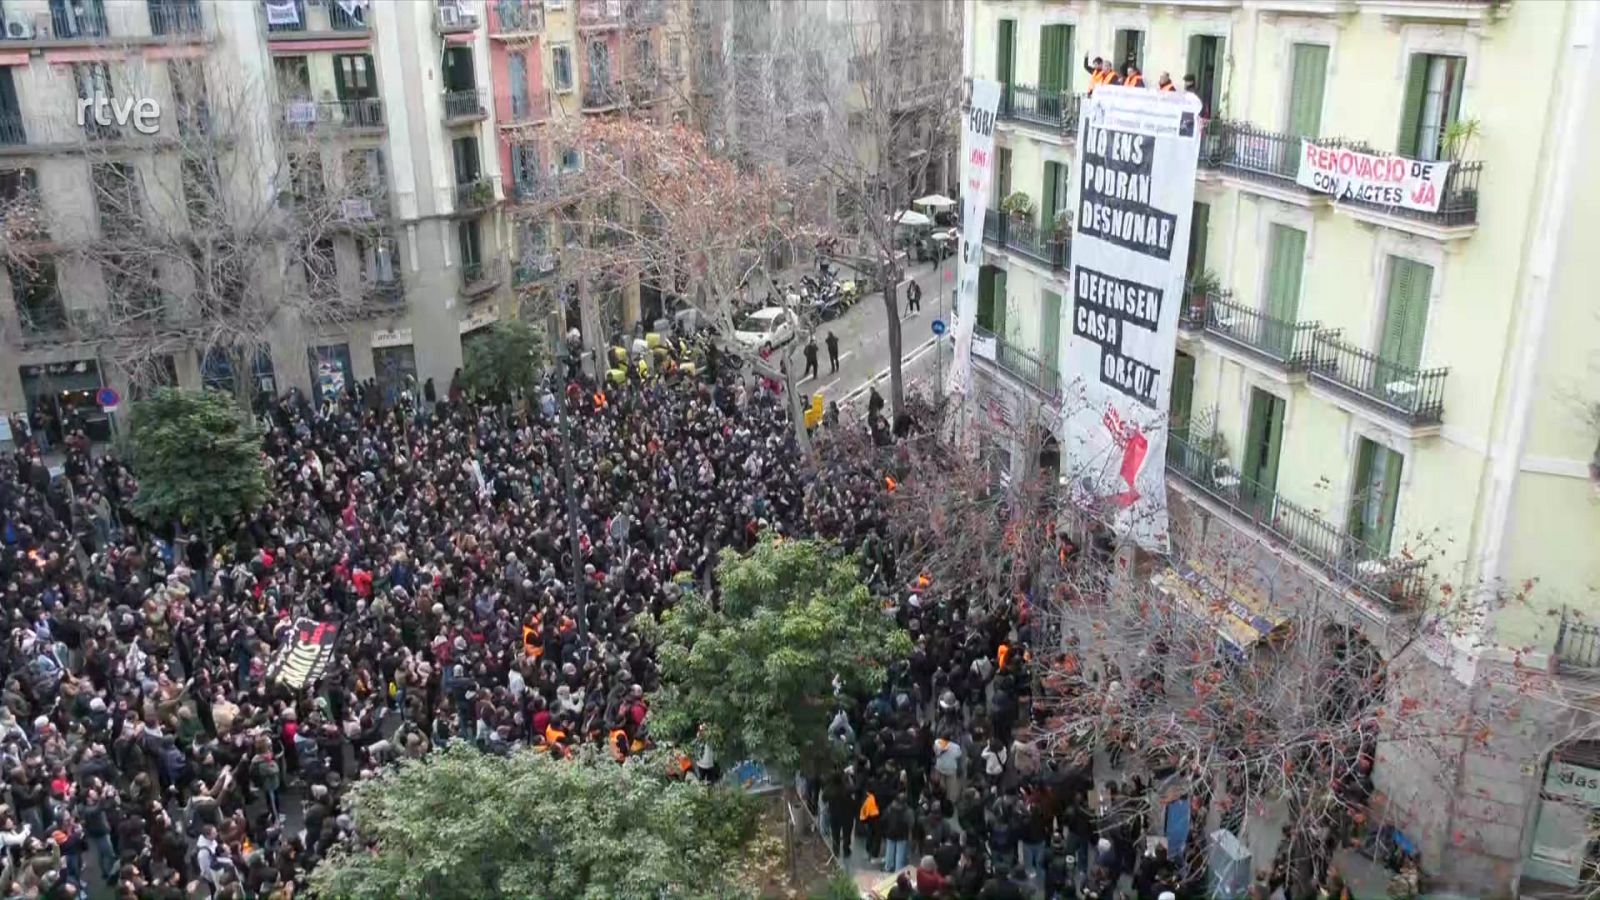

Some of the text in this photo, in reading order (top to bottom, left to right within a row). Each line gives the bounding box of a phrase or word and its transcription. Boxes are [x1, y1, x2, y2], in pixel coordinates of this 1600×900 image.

[1086, 127, 1144, 165] NO ENS
[1084, 164, 1151, 204] PODRAN
[1314, 172, 1402, 203] CONACTES
[1411, 163, 1433, 180] DE
[1082, 203, 1170, 249] DESNONAR
[1077, 305, 1117, 345] CASA
